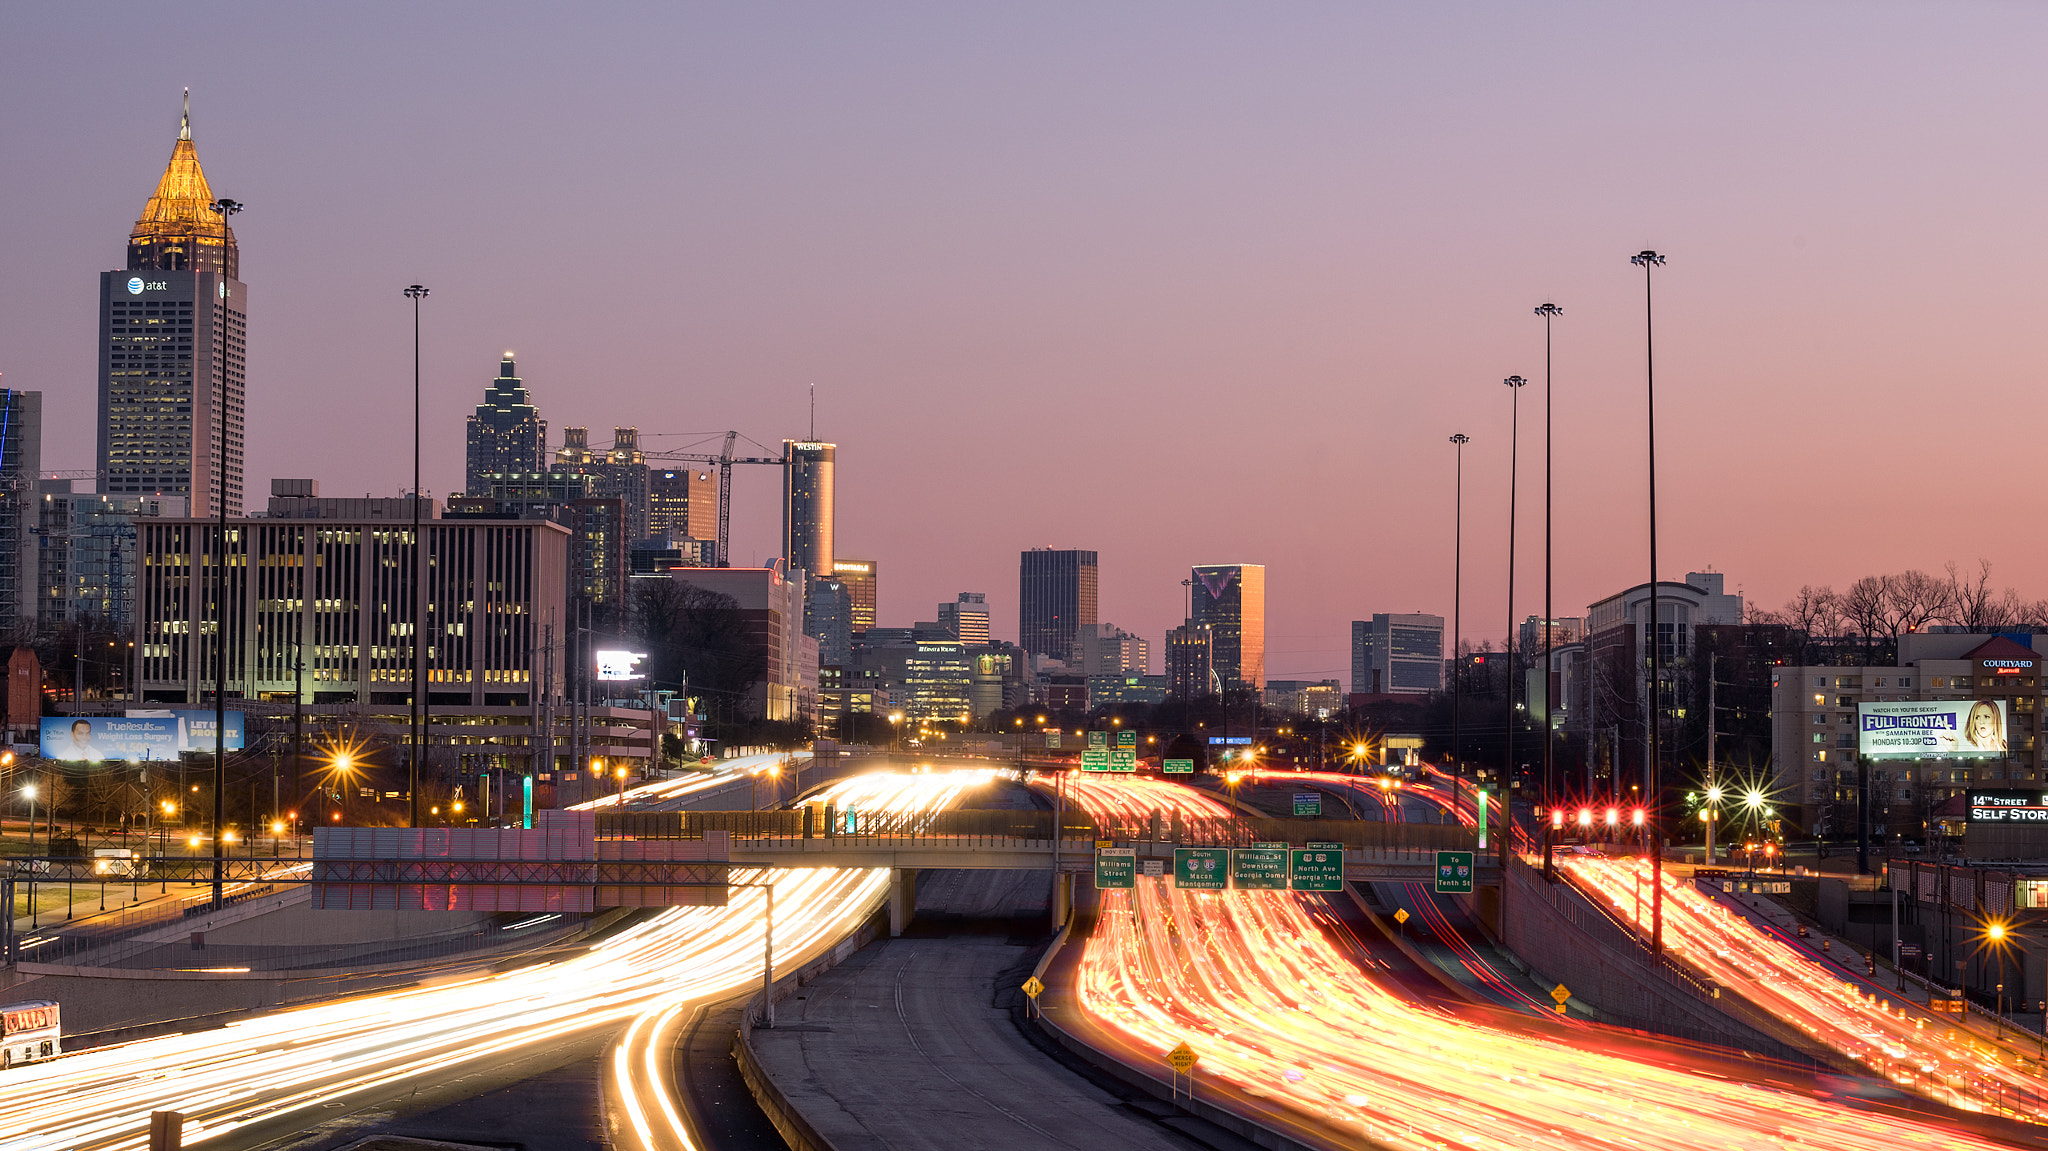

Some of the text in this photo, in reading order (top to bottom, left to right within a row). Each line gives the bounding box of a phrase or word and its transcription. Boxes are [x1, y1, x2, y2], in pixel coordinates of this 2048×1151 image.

[146, 281, 167, 290] at&t
[797, 443, 822, 451] WESTIN
[1983, 660, 2033, 668] COURTYARD
[191, 721, 208, 729] LET
[1866, 715, 1953, 729] FULL FRONTAL
[98, 732, 123, 741] Weight
[144, 732, 173, 742] Surgery
[191, 729, 217, 737] PROV
[1873, 738, 1901, 746] MONDAYS
[1902, 738, 1922, 746] 10:30P
[1973, 795, 2028, 806] 14TH STREET
[1972, 808, 2048, 820] SELF STOR
[1234, 872, 1262, 880] Georgia
[1293, 874, 1321, 882] Georgia
